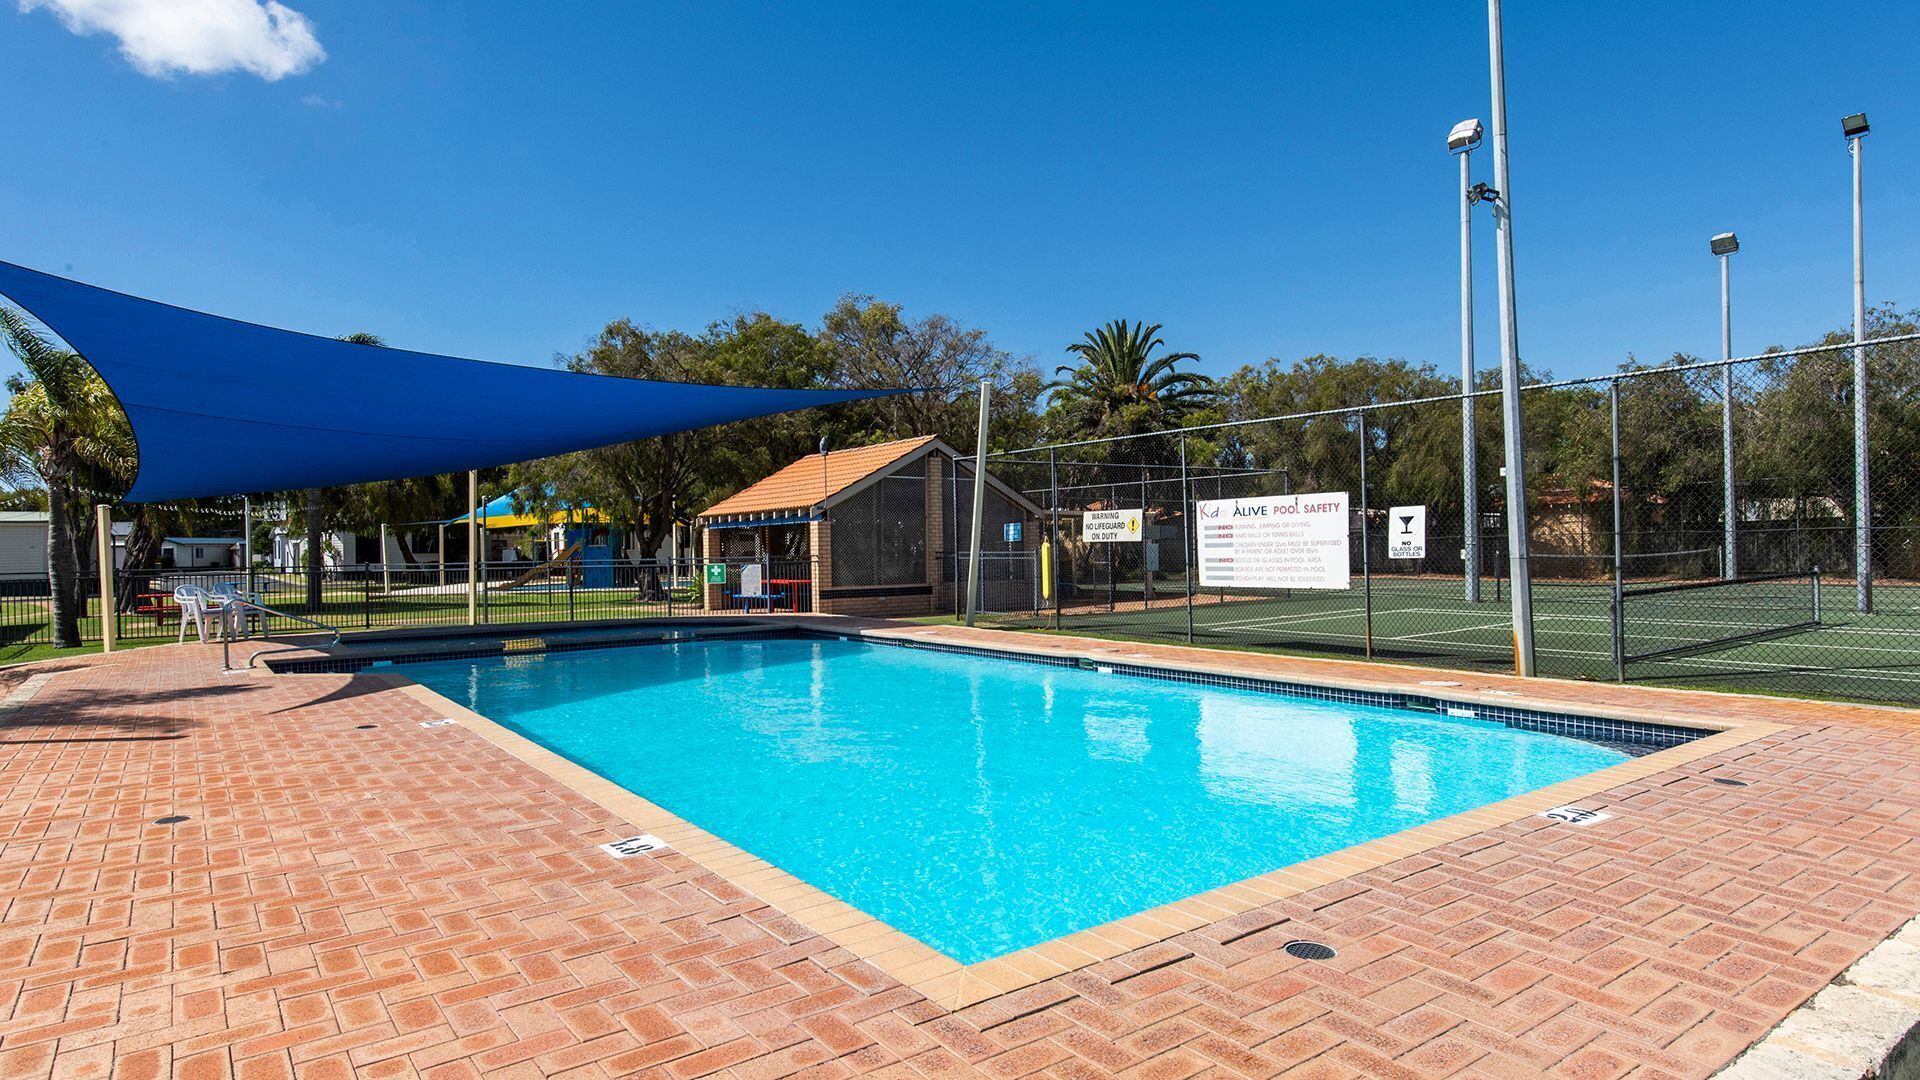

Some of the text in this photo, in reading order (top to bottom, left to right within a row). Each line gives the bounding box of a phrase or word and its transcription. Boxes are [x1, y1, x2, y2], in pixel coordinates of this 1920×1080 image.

[1200, 502, 1341, 520] Kd ALIVE POOL SAFETY
[1091, 511, 1119, 520] WARNING
[1085, 522, 1126, 530] NO LIFEGUARD
[1101, 532, 1118, 540] DUTY
